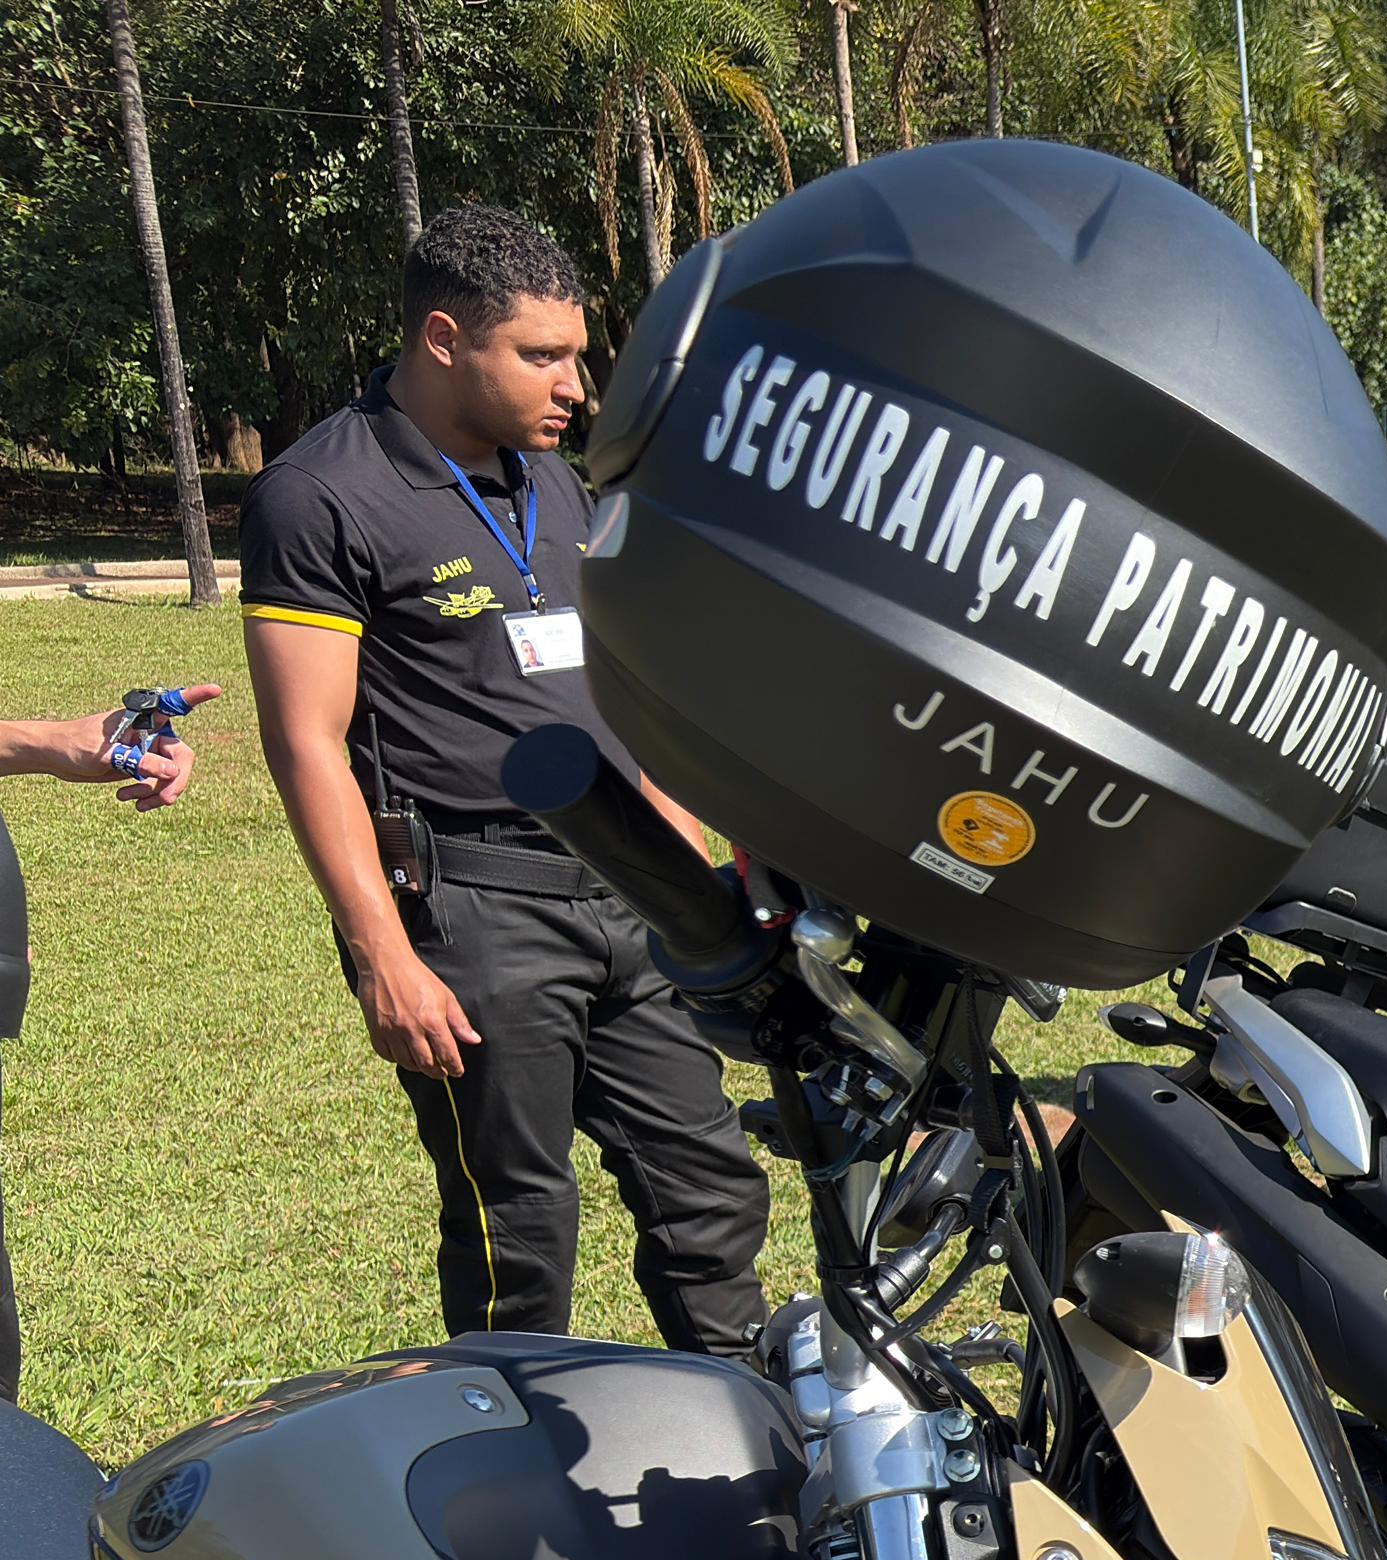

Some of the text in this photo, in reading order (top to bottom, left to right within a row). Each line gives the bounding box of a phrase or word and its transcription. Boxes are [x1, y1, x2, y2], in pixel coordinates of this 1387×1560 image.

[432, 556, 472, 583] JAHU
[703, 345, 1385, 793] SEGURANÇA PATRIMONIAL
[893, 690, 1150, 828] JAHU
[394, 869, 407, 884] 8
